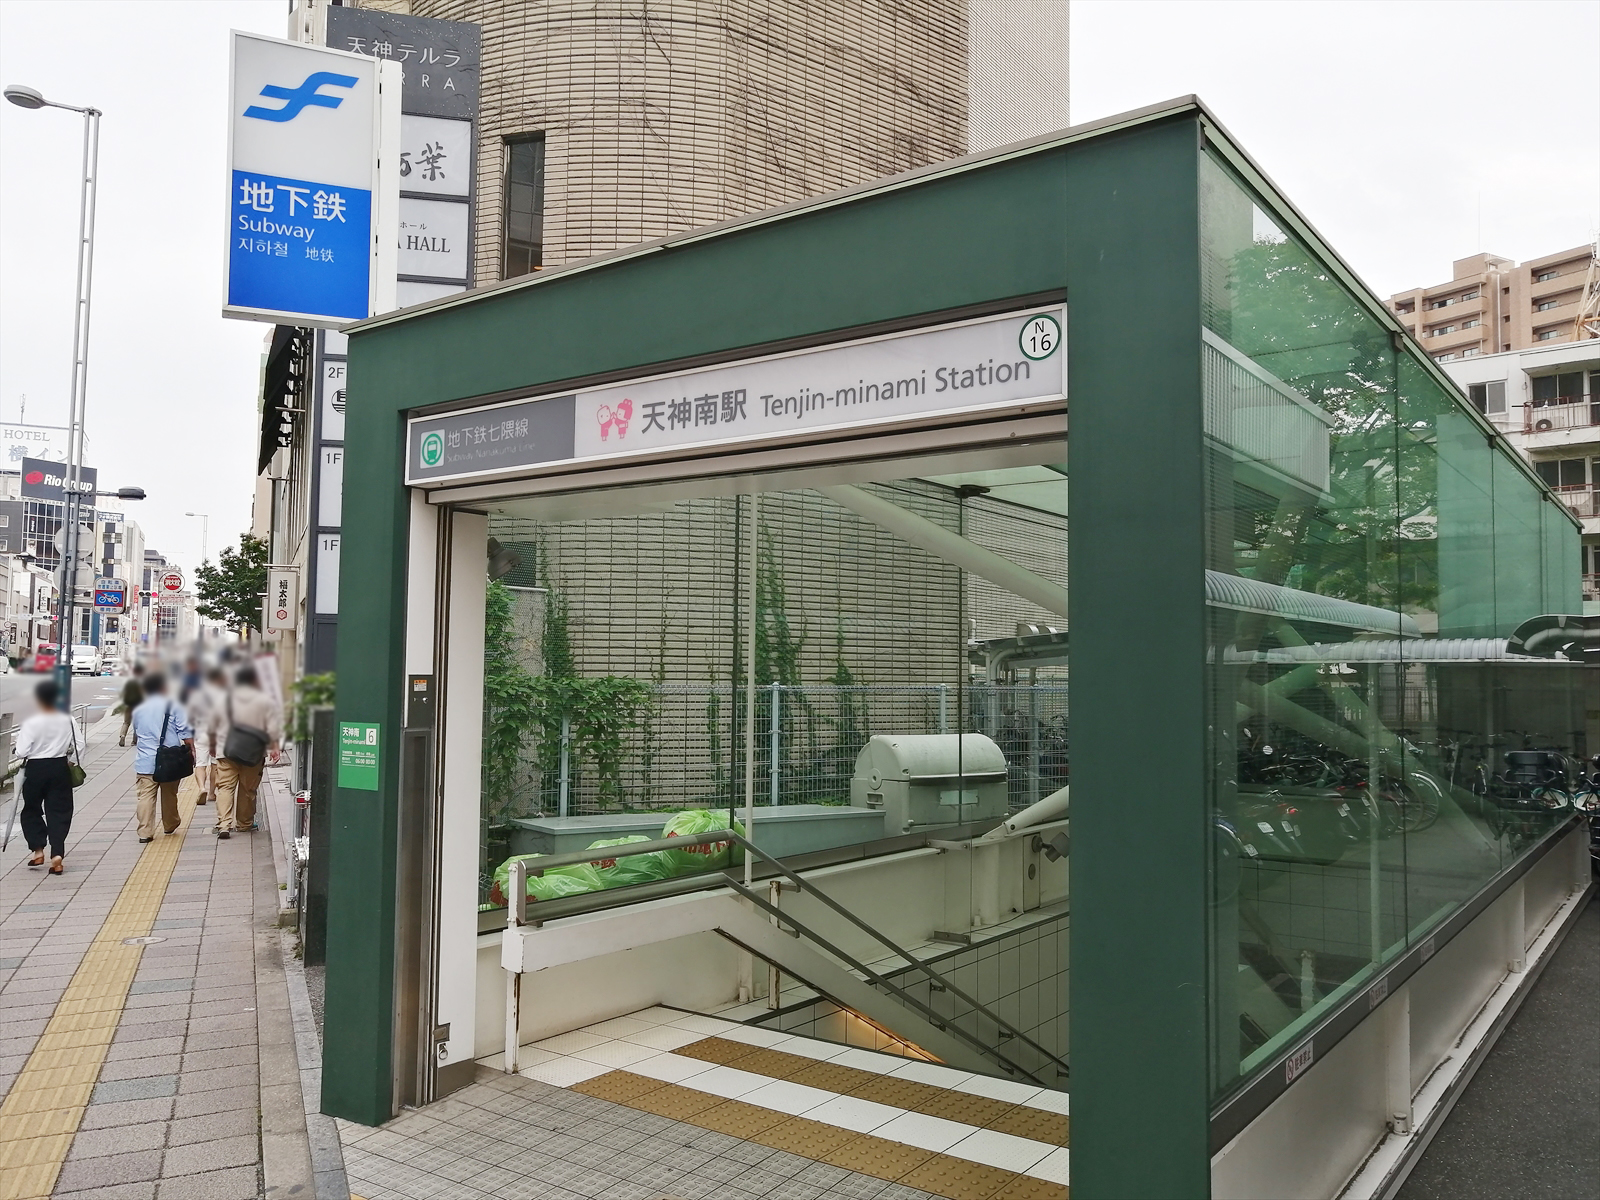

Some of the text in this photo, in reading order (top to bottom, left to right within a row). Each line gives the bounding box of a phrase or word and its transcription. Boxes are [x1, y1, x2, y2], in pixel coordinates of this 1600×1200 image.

[347, 36, 461, 68] 天神テルラ
[239, 178, 347, 224] 地下鉄
[238, 214, 315, 243] Subway
[238, 237, 288, 258] 지하철
[406, 235, 451, 253] HALL
[304, 246, 335, 263] 地铁
[1034, 320, 1046, 334] N
[1029, 333, 1052, 353] 16
[328, 366, 346, 379] 2F
[760, 358, 1031, 419] Tenjin-minami Station
[641, 388, 748, 435] 天神南駅
[3, 428, 51, 442] HOTEL
[447, 417, 530, 449] 地下鉄七隈線
[326, 453, 342, 465] 1F
[446, 451, 475, 463] Subway
[475, 445, 518, 459] Nanakuma
[43, 474, 62, 488] Rio
[323, 539, 340, 551] 1F
